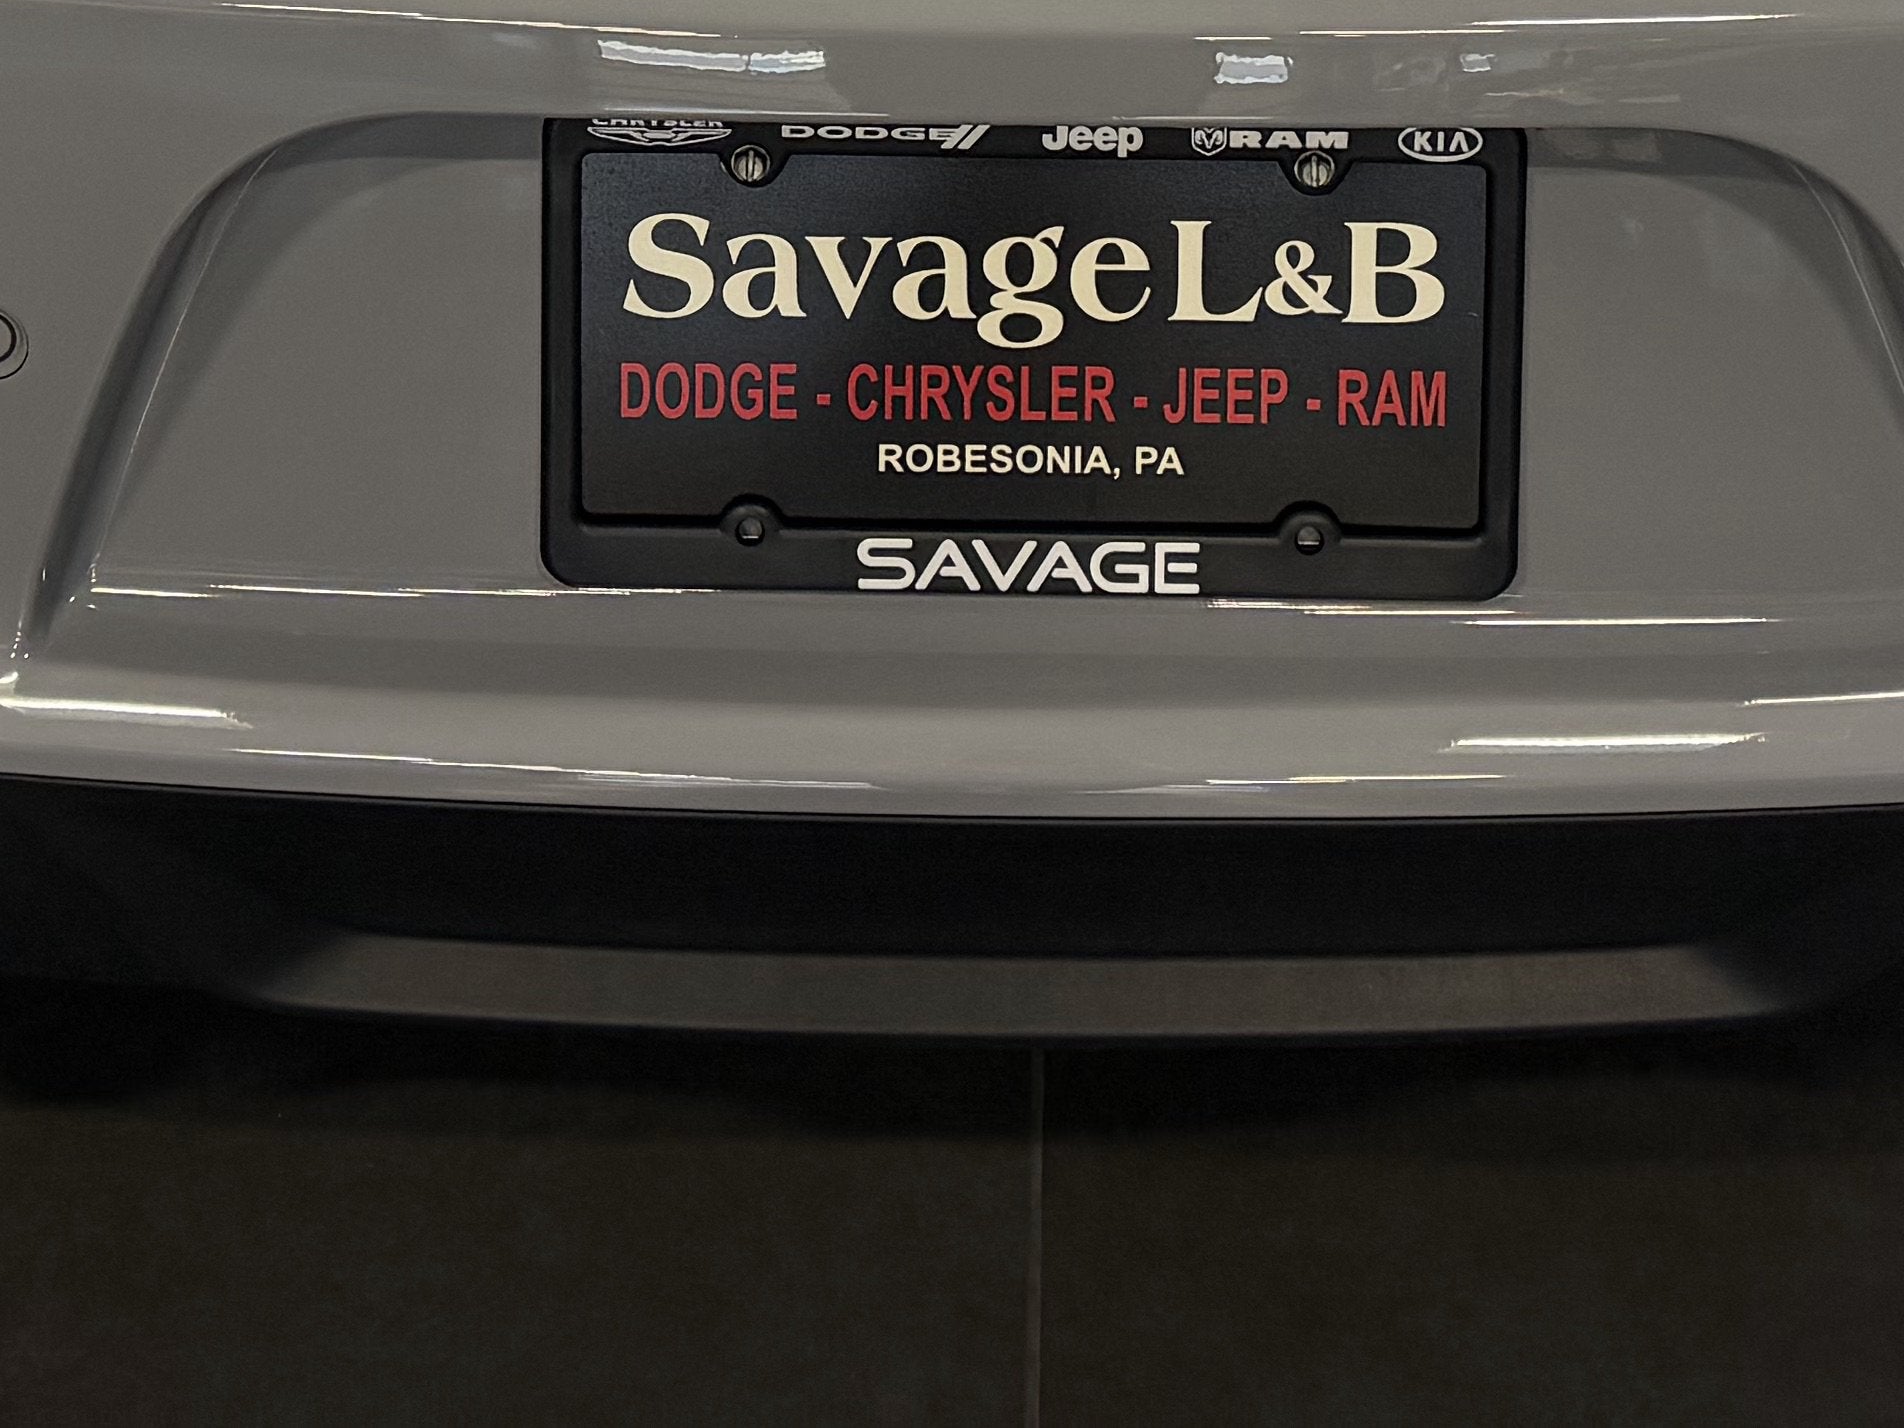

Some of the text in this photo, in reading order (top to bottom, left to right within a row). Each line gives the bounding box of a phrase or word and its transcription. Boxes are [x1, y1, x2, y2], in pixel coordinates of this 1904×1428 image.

[781, 124, 953, 142] DODGE
[1041, 125, 1144, 158] Jeep
[1229, 130, 1349, 149] RAM
[1413, 131, 1469, 153] KIA
[619, 362, 799, 420] DODGE
[846, 362, 1116, 423] CHRYSLER
[1162, 366, 1290, 425] JEEP
[1337, 369, 1448, 427] RAM
[877, 442, 1185, 481] ROBESONIA, PA
[856, 537, 1202, 595] SAVAGE
